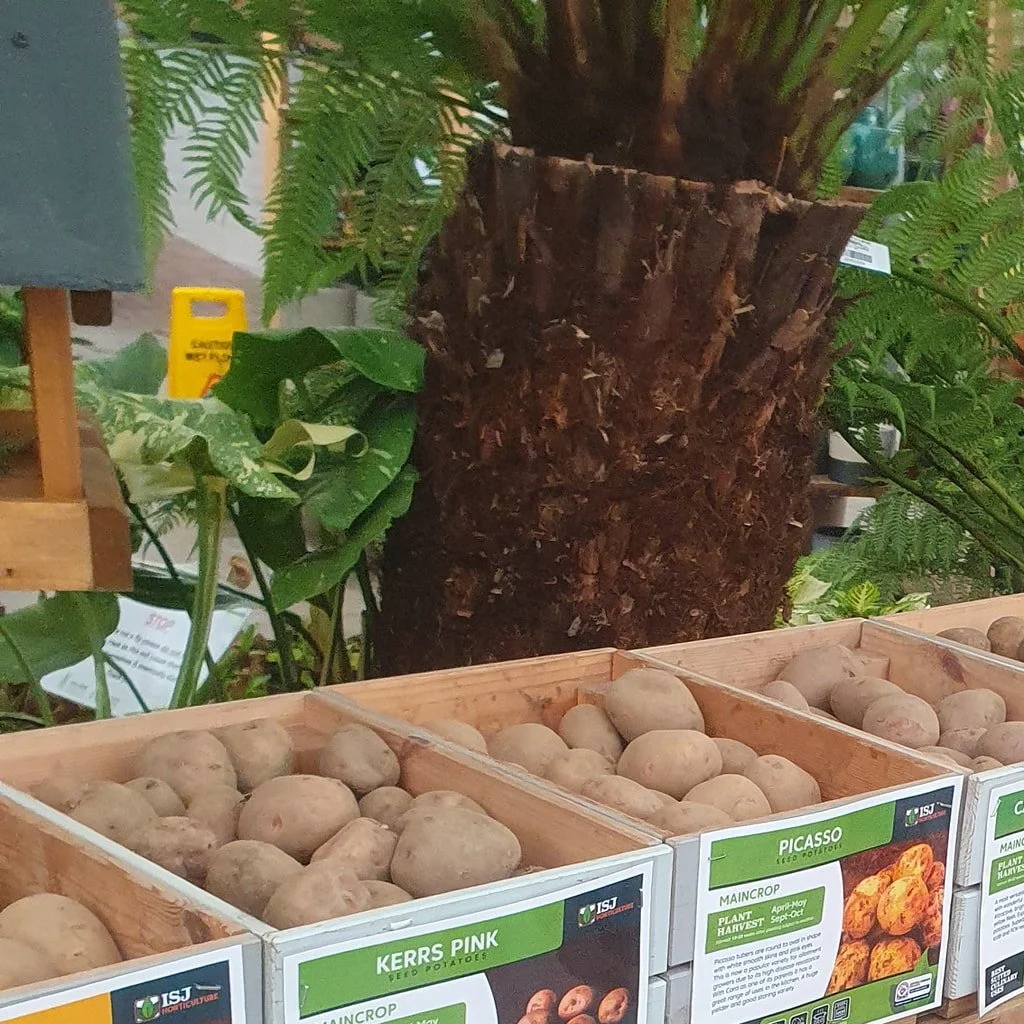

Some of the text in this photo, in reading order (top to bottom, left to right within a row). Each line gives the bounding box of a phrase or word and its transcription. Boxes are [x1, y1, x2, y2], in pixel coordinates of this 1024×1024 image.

[920, 803, 935, 817] ISJ
[779, 826, 842, 855] PICASSO
[776, 843, 842, 864] SEED POTATOES
[998, 856, 1023, 870] PLANT
[597, 897, 617, 914] ISJ
[719, 884, 780, 906] MAINCROP
[717, 908, 804, 937] HARVEST Sept-Oct
[718, 899, 807, 926] PLANT April-May
[377, 929, 499, 974] KERRS PINK
[389, 952, 487, 982] SEED POTATOES
[161, 986, 192, 1008] ISJ
[162, 992, 219, 1014] HORTICULTURE
